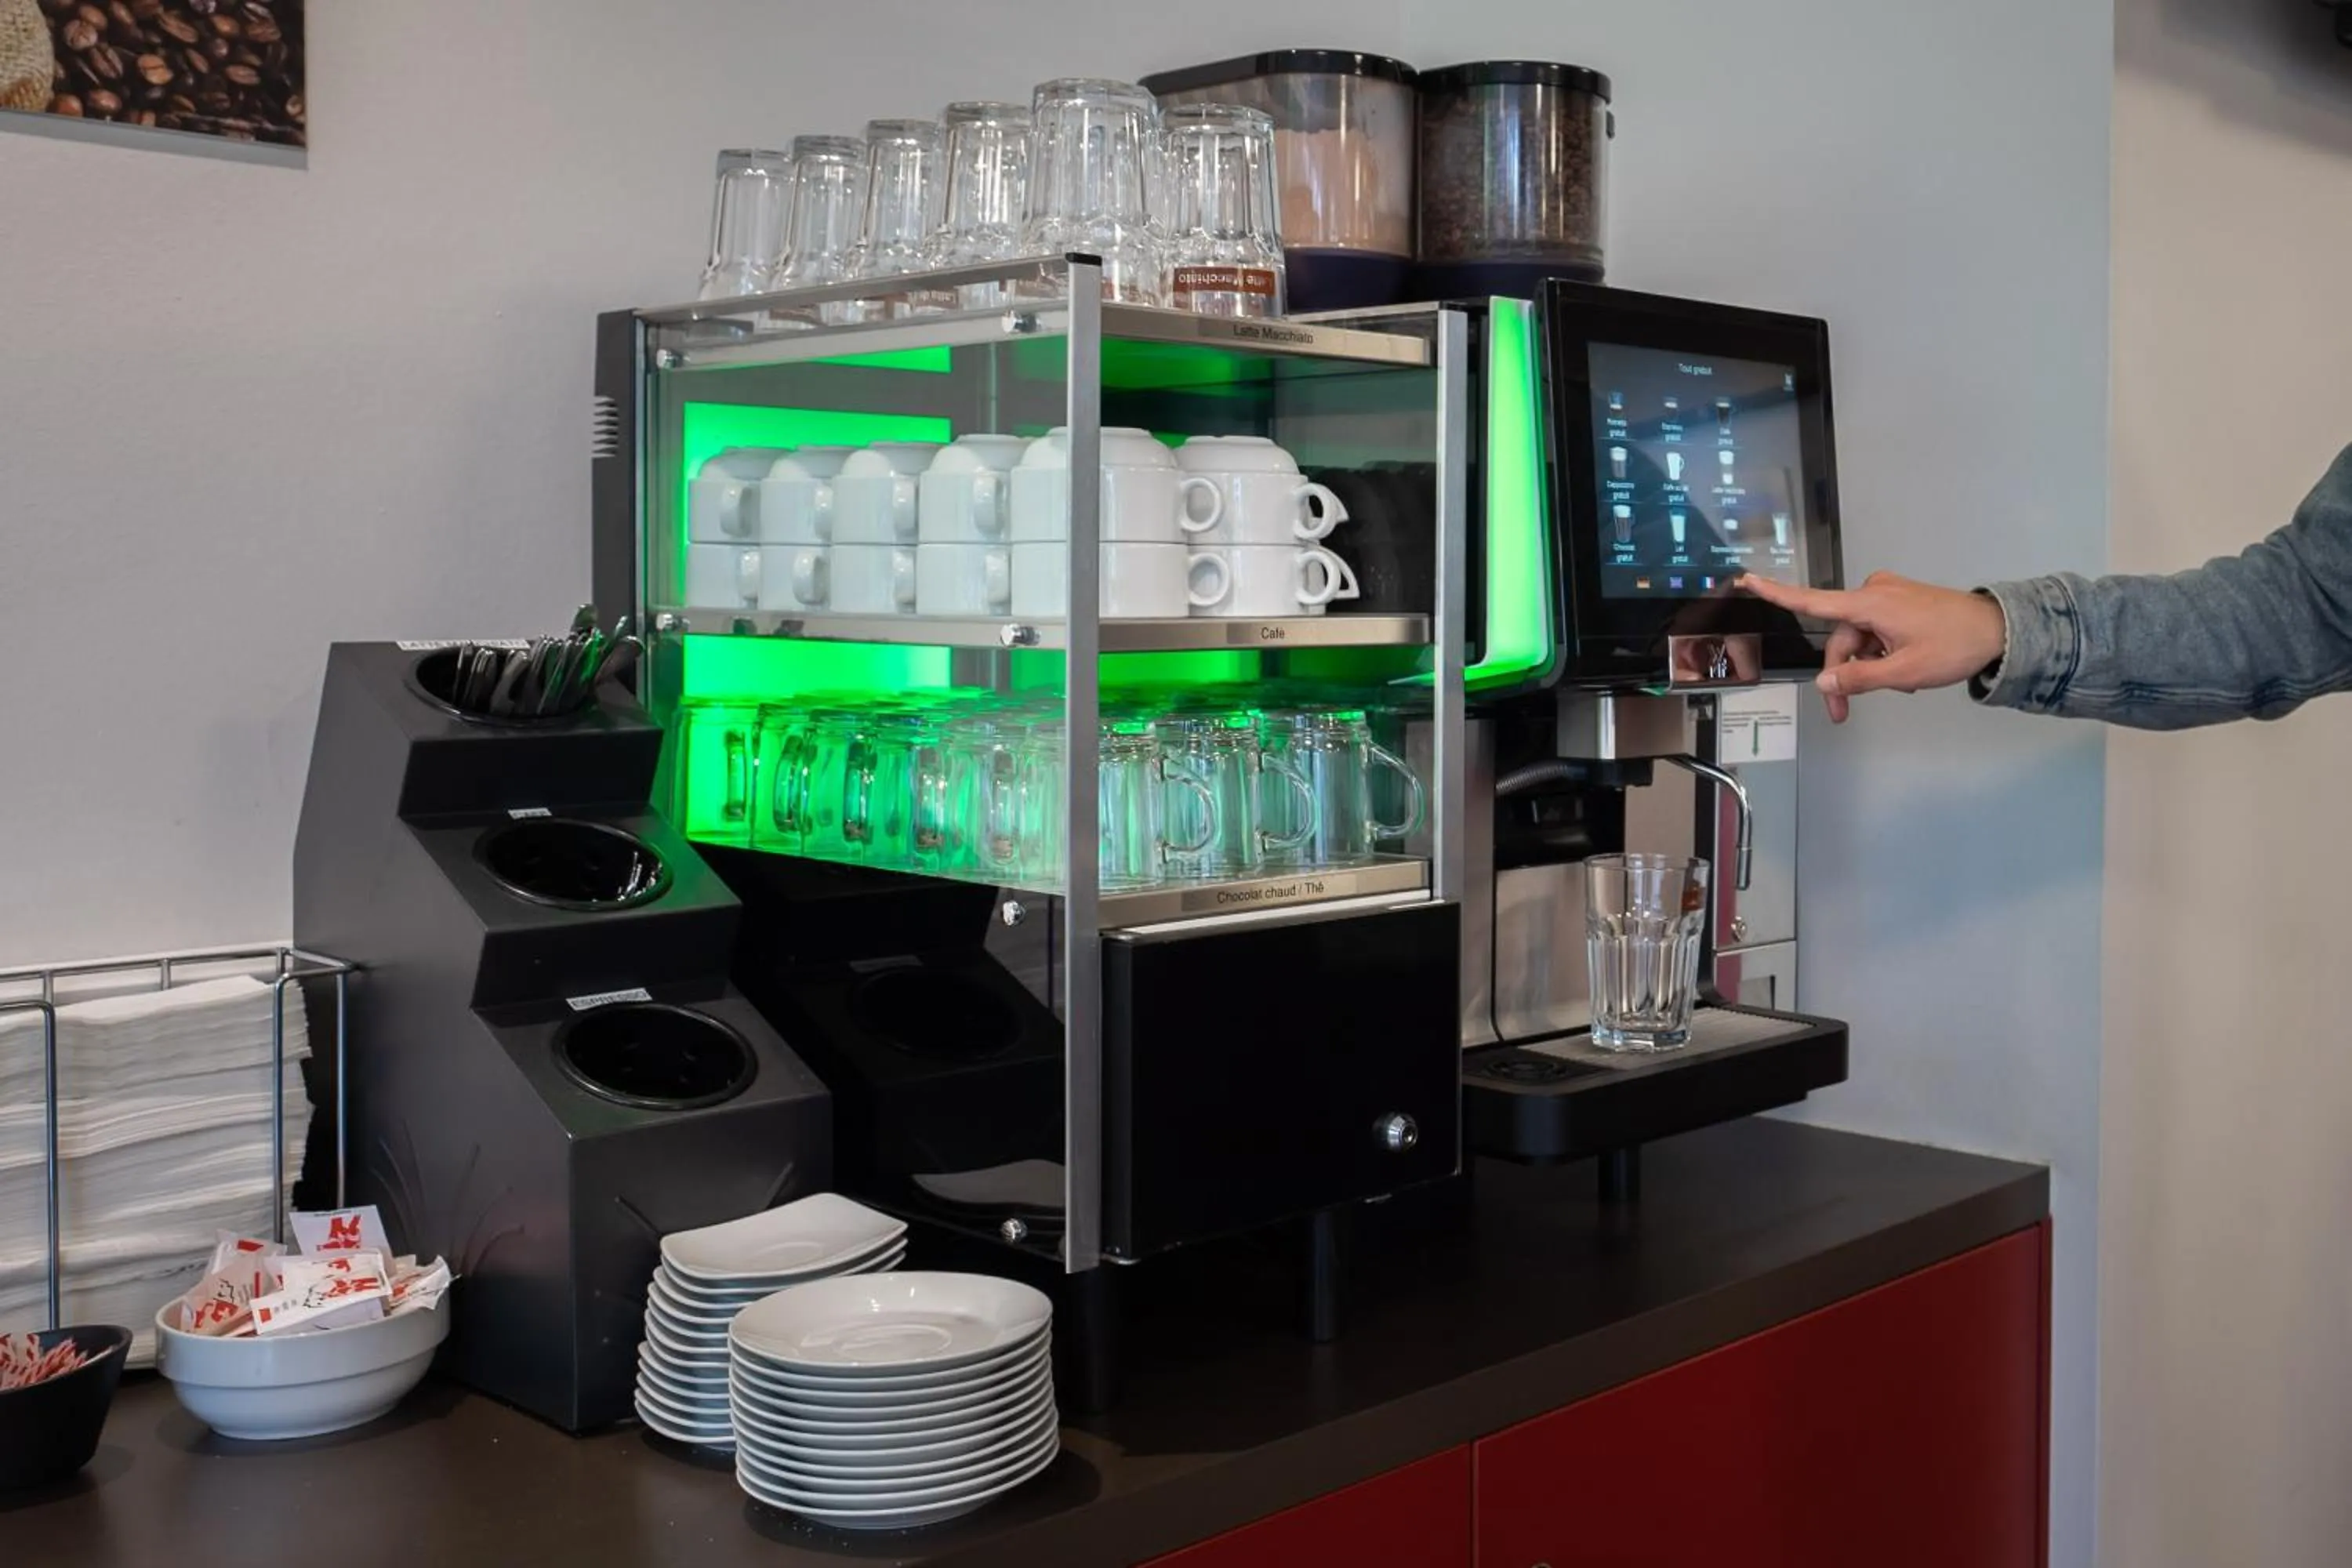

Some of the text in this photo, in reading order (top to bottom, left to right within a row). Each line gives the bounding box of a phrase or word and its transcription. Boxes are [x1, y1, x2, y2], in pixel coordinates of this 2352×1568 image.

[1233, 324, 1314, 344] Latte Macchiato
[1217, 887, 1263, 904] Chocolat
[1265, 883, 1297, 899] chaud
